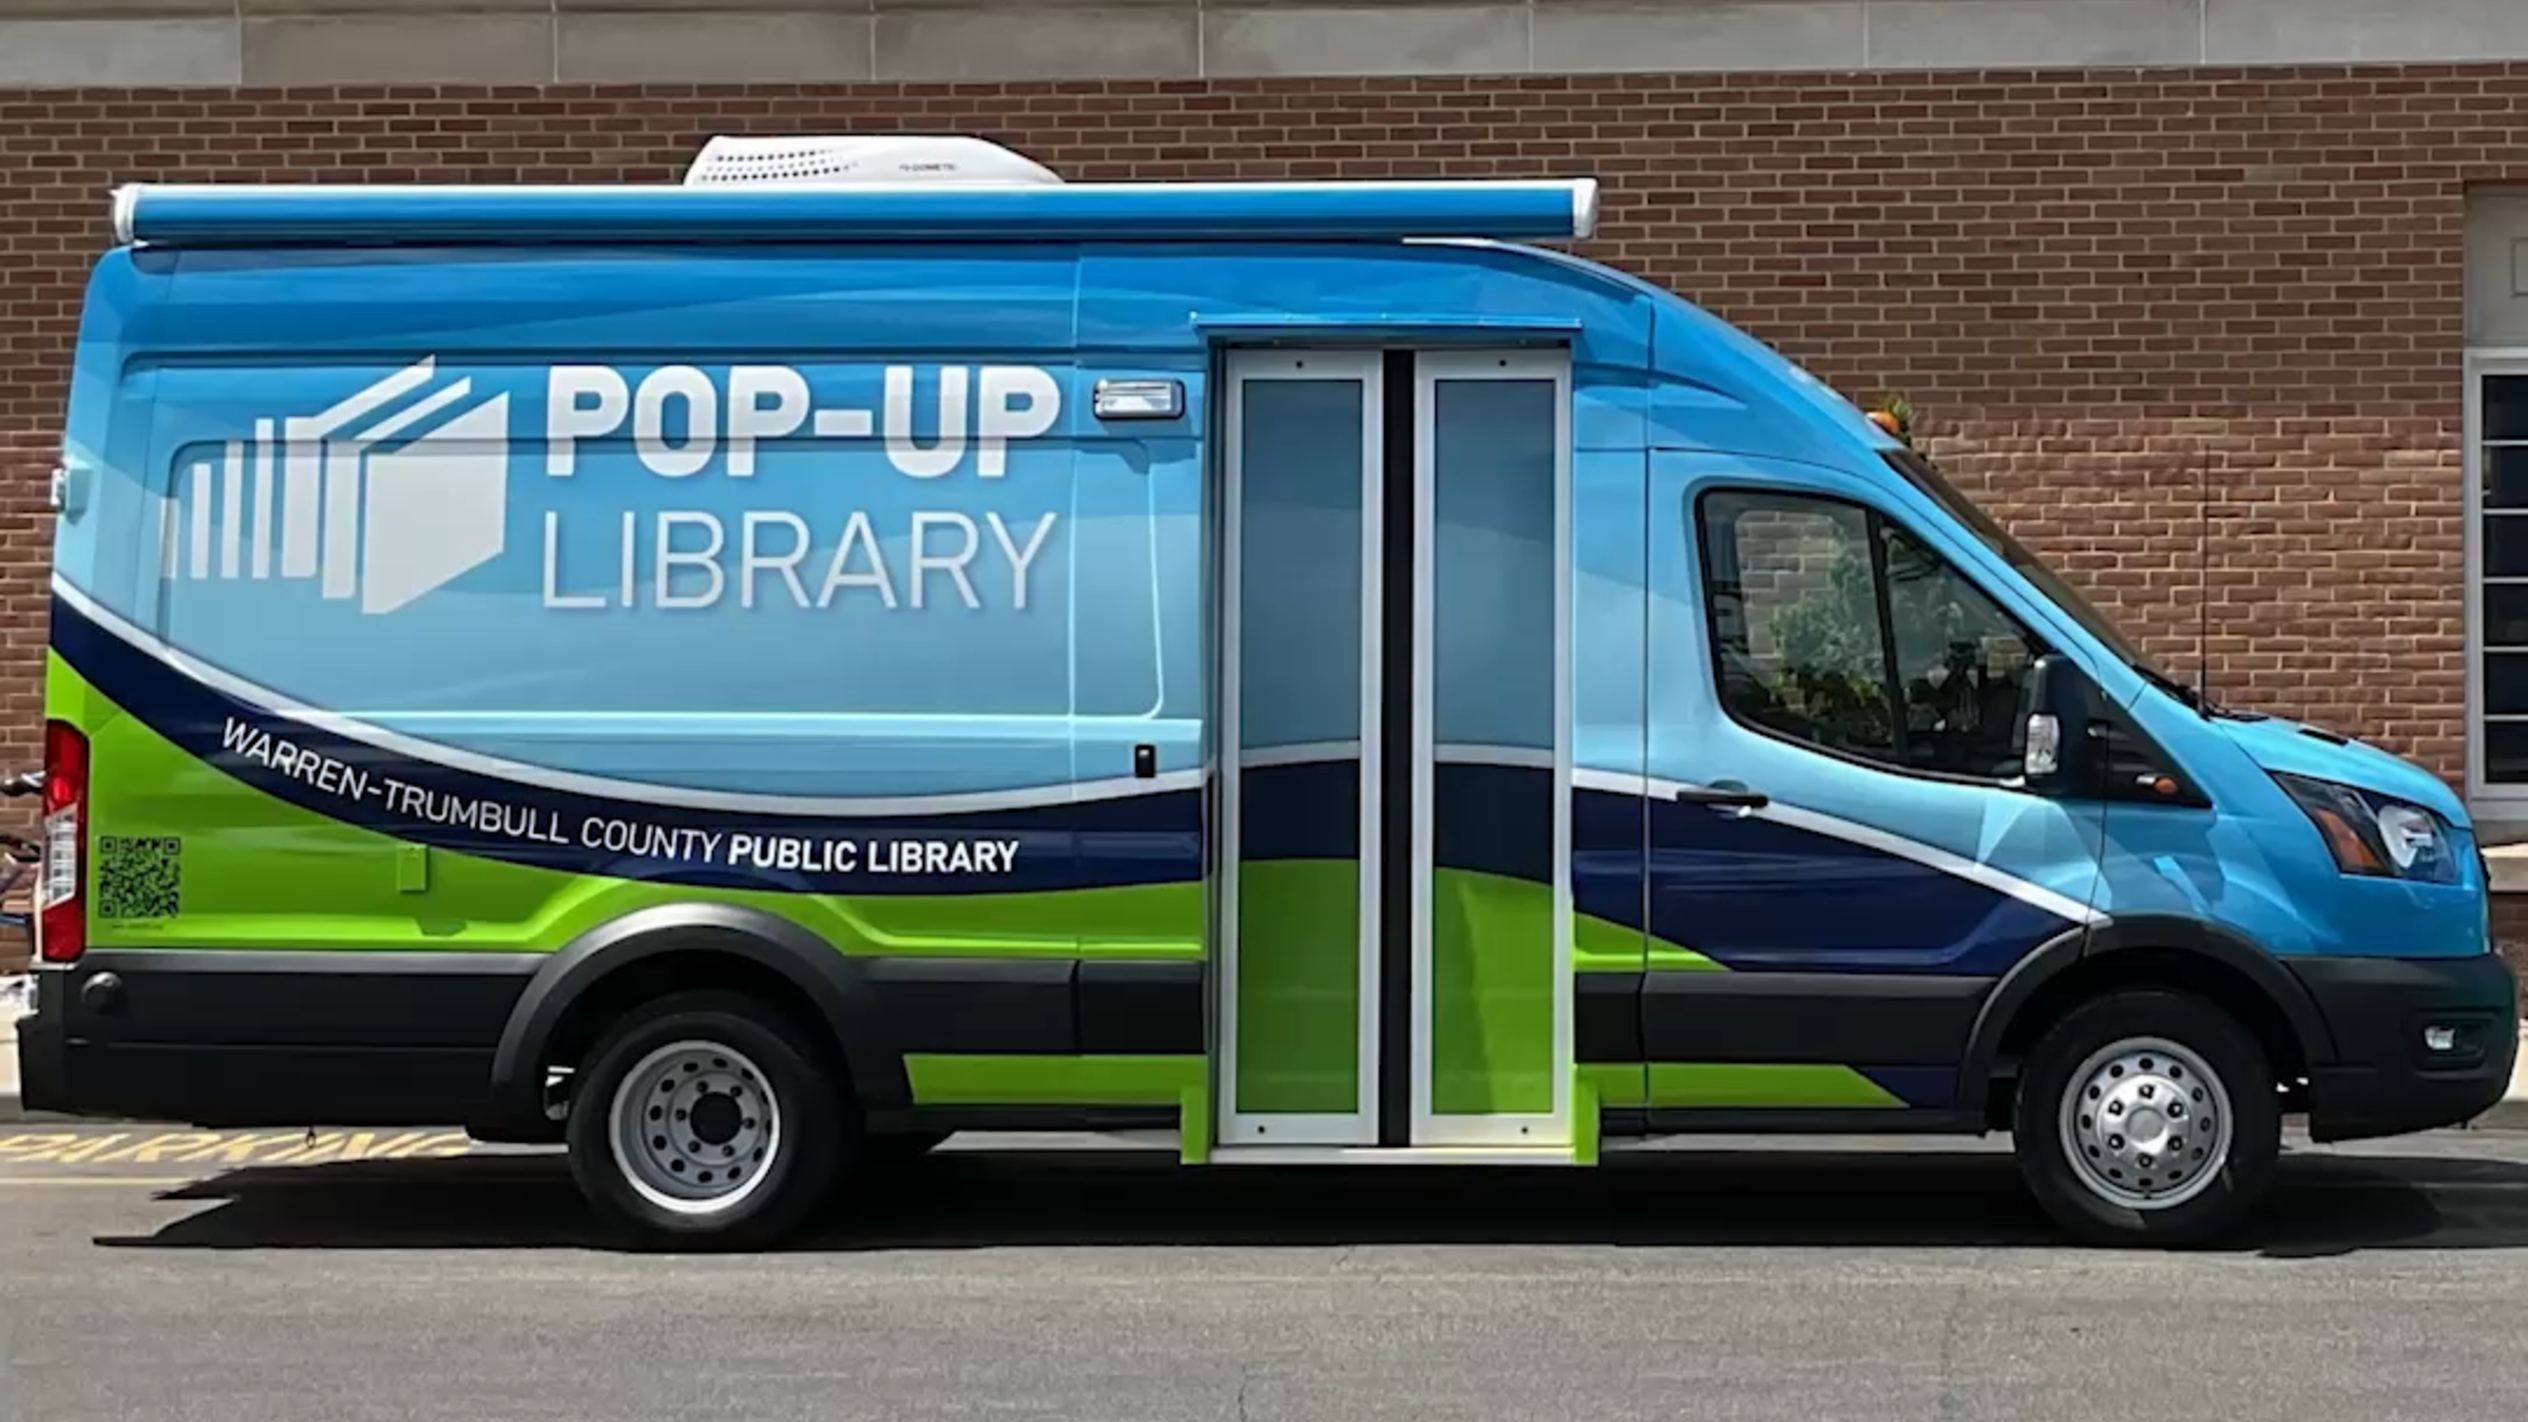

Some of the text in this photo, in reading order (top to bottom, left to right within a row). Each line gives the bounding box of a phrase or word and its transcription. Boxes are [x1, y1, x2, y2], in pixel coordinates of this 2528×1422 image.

[546, 365, 1061, 478] POP-UP
[543, 511, 1057, 608] LIBRARY
[221, 717, 1019, 873] WARREN-TRUMBULL COUNTY PUBLIC LIBRARY
